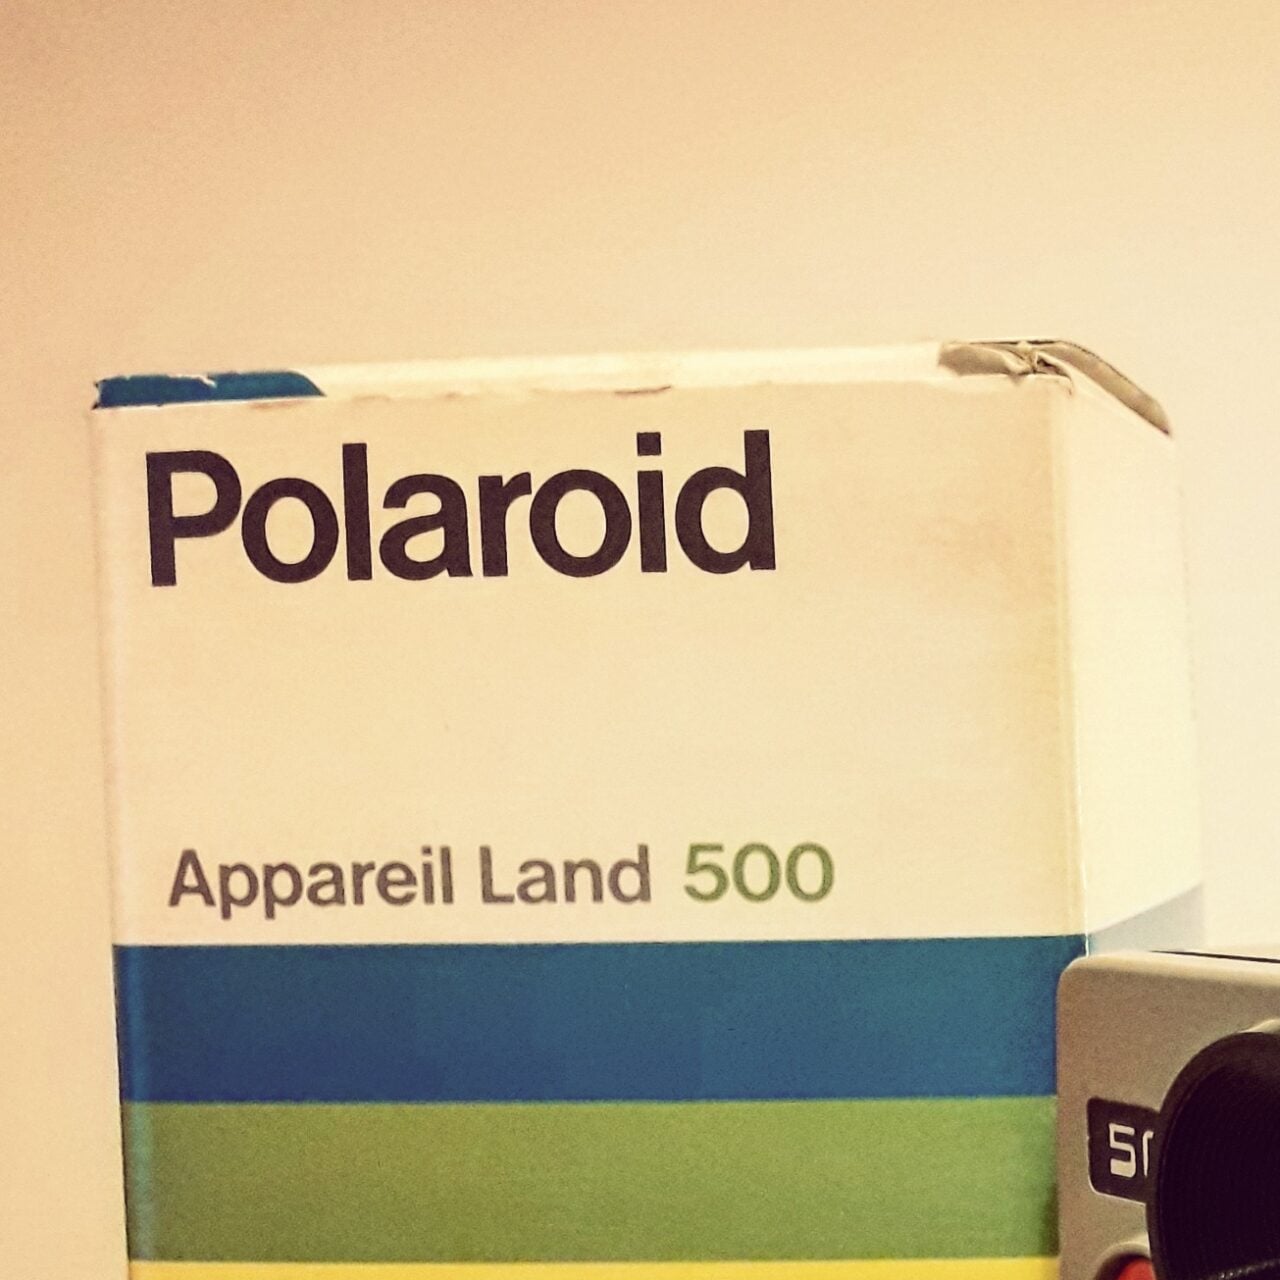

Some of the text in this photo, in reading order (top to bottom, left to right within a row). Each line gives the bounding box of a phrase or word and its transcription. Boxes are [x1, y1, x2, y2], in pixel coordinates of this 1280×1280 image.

[146, 430, 776, 586] Polaroid
[168, 842, 835, 920] Appareil Land 500
